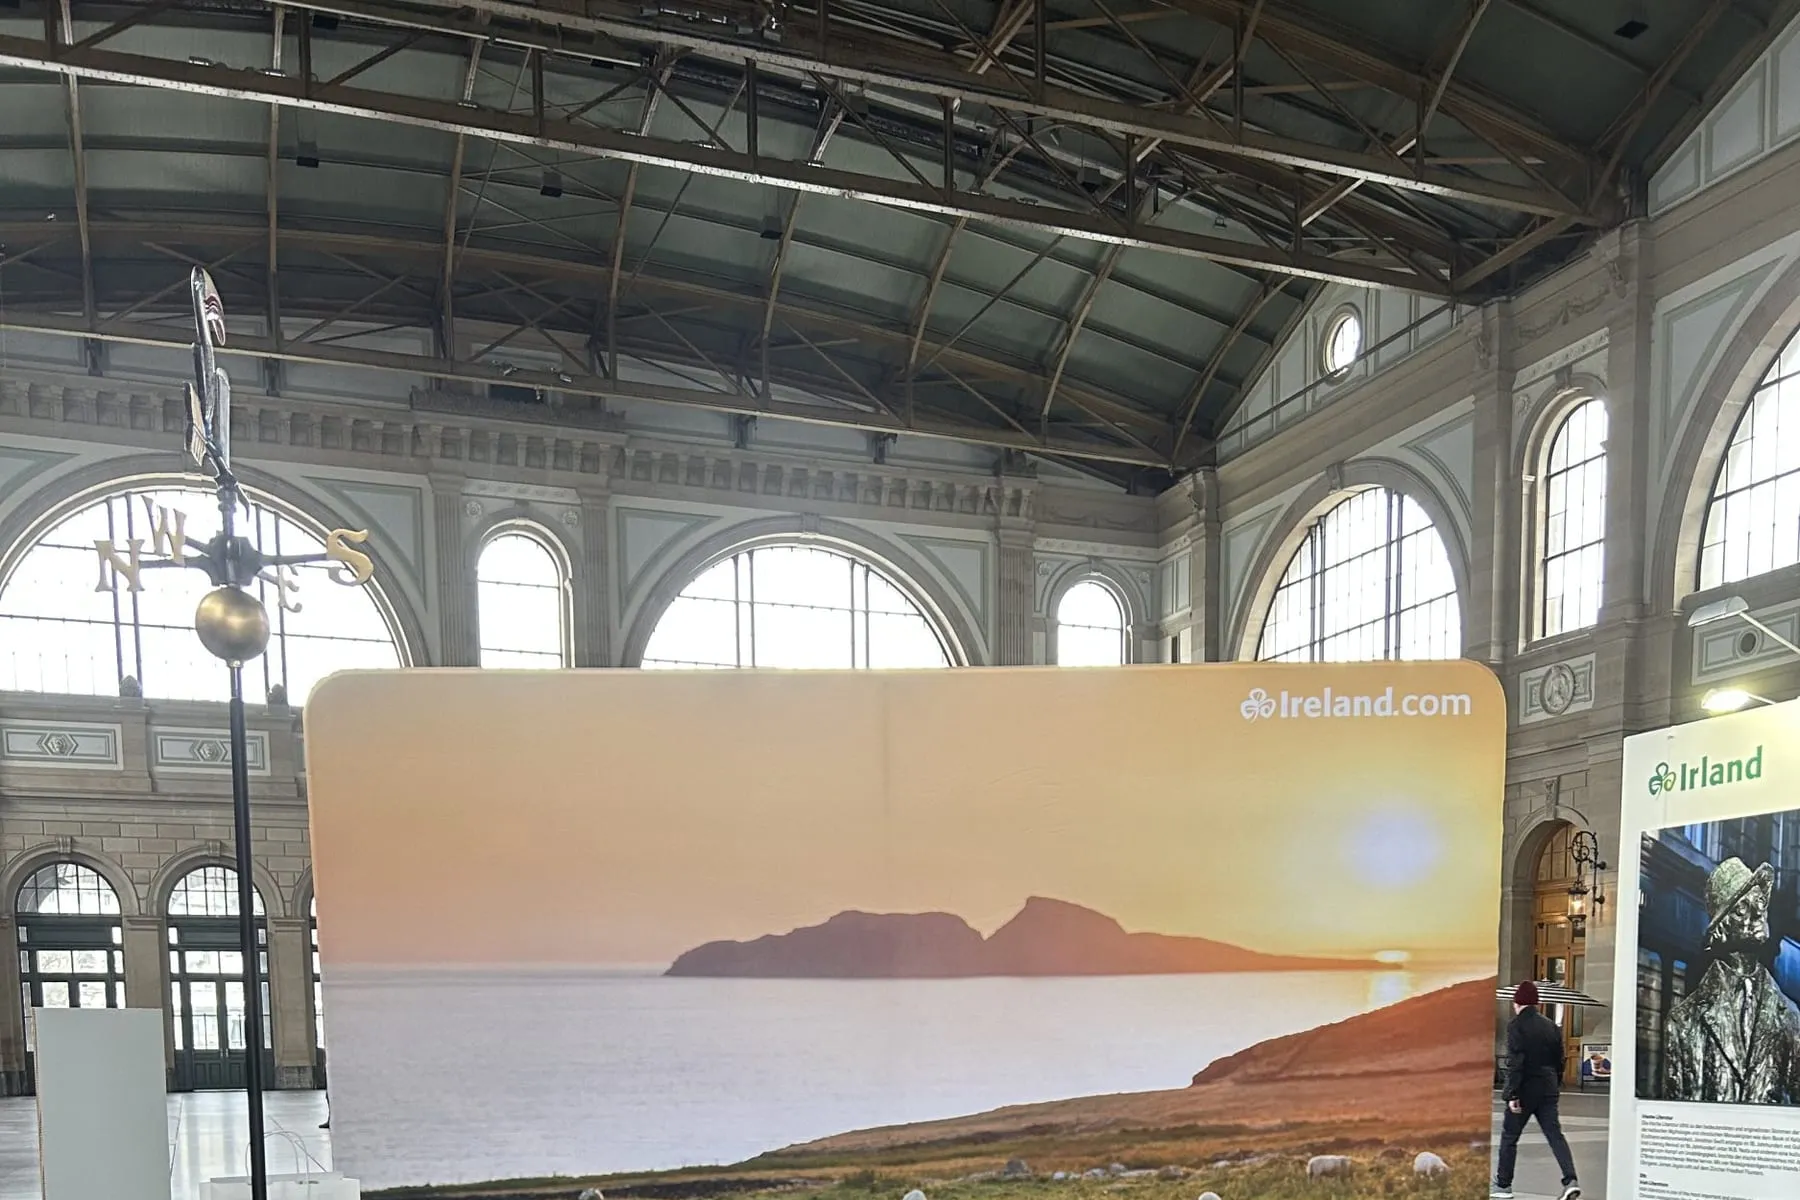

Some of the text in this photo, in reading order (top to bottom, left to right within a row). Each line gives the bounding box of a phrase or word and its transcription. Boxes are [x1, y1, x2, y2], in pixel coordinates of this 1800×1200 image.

[141, 494, 187, 565] W
[93, 539, 145, 592] N
[326, 528, 375, 586] S
[1280, 686, 1472, 718] Ireland.com
[1680, 745, 1762, 791] Irland
